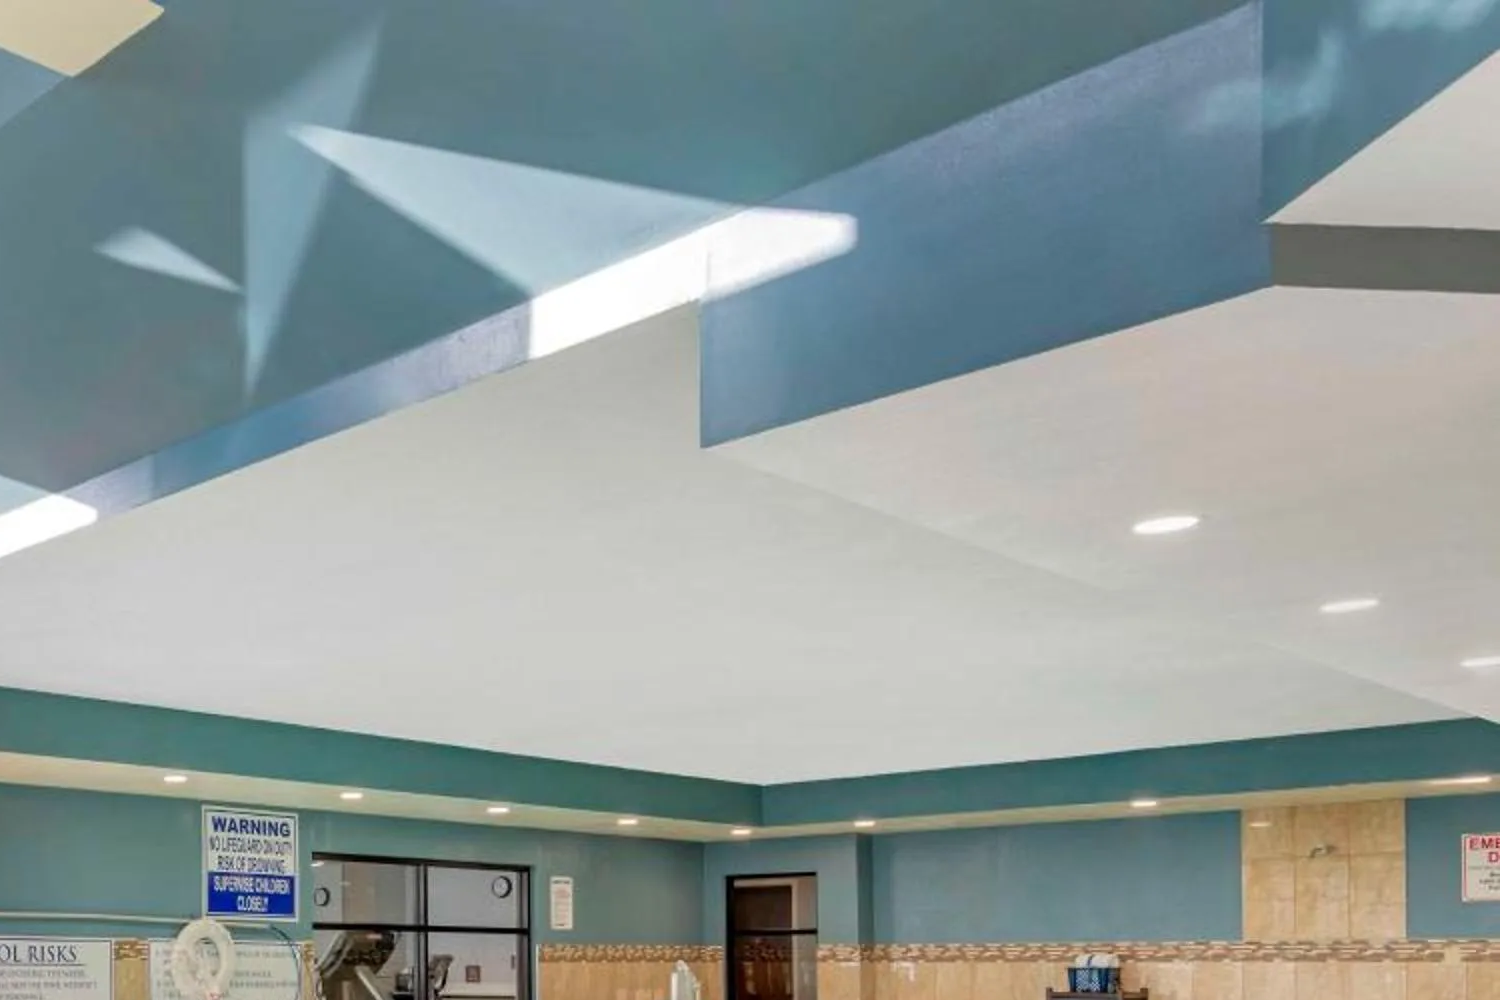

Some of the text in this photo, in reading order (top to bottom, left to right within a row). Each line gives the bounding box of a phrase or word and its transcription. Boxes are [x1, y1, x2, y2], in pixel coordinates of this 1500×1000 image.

[211, 815, 292, 837] WARNING
[209, 835, 220, 852] NO
[222, 837, 262, 855] LIFEGUARD
[217, 855, 235, 870] RISK
[213, 875, 291, 895] SUPERVISE CHILDREN
[28, 944, 78, 964] RISKS
